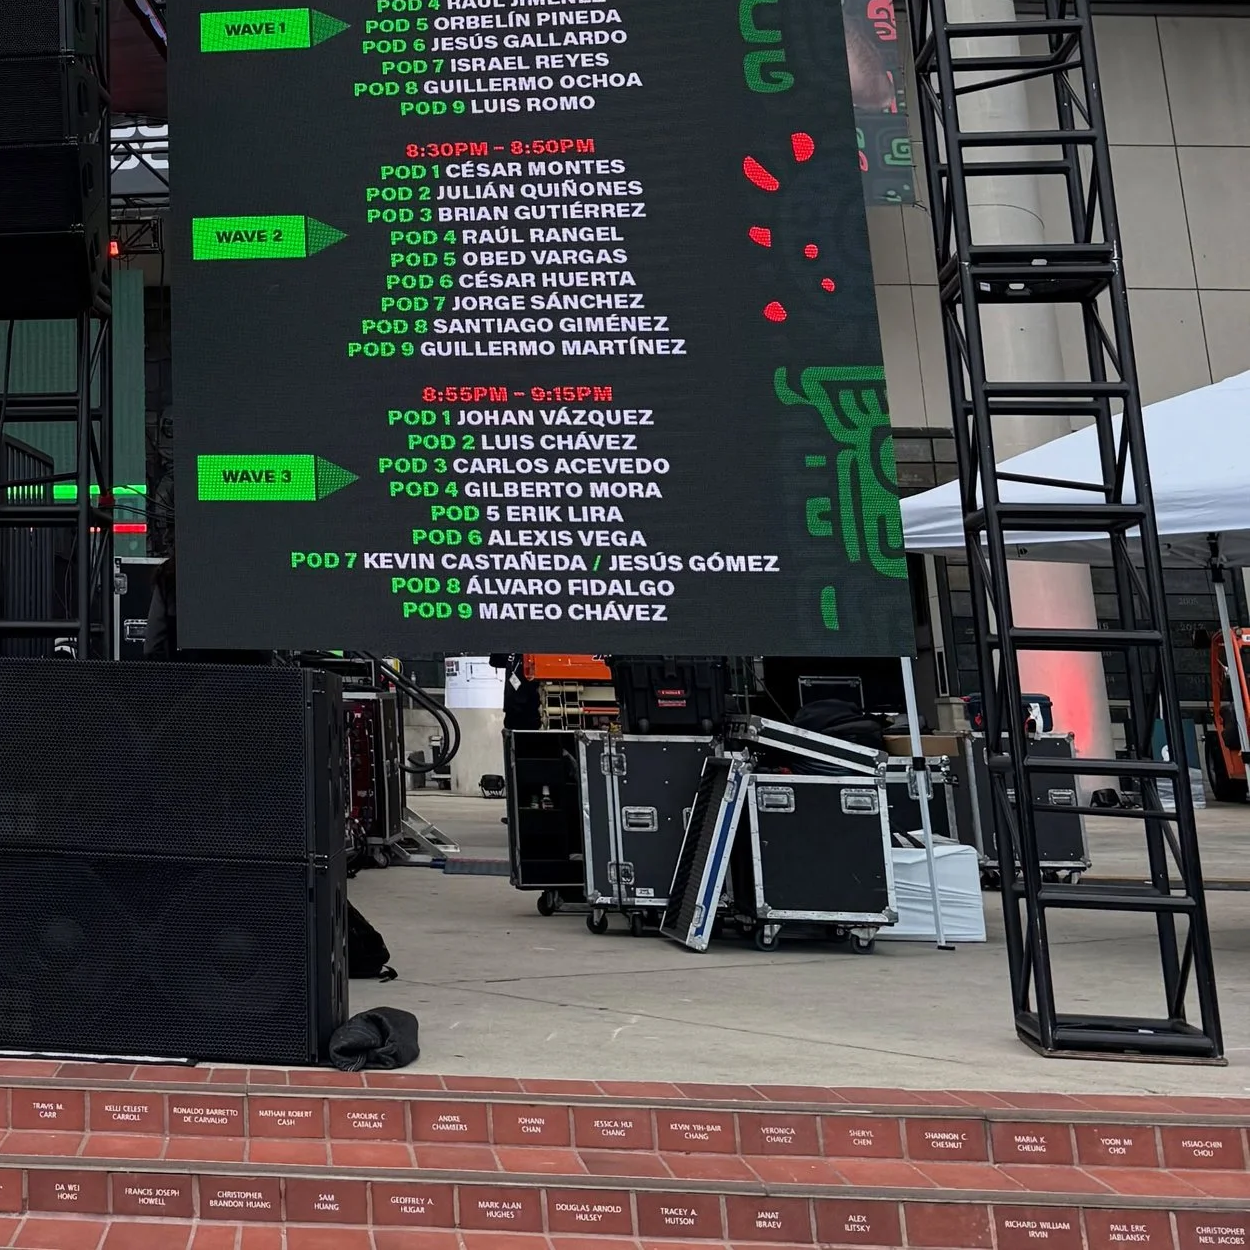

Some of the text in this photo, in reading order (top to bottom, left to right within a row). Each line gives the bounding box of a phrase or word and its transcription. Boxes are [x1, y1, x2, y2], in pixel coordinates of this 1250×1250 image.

[366, 9, 622, 33] POD 5 ORBELÍN PINEDA
[225, 22, 285, 36] WAVE 1
[355, 73, 642, 96] POD 8 GUILLERMO OCHOA
[401, 96, 595, 115] POD 9 LUIS ROMO
[407, 142, 488, 157] 8:30PM
[511, 139, 594, 154] 8:50PM
[381, 160, 625, 179] POD 1 CÉSAR MONTES
[216, 229, 283, 243] WAVE 2
[391, 226, 624, 245] POD 4 RAÚL RANGEL
[387, 271, 636, 289] POD 6 CÉSAR HUERTA
[382, 292, 644, 311] POD 7 JORGE SÁNCHEZ
[349, 336, 686, 356] POD 9 GUILLERMO MARTÍNEZ
[423, 387, 507, 401] 8:55PM
[531, 387, 612, 401] 9:15PM
[389, 407, 654, 427] POD 1 JOHAN VÁZQUEZ
[409, 431, 637, 450] POD 2 LUIS CHÁVEZ
[223, 470, 291, 483] WAVE 3
[390, 482, 662, 498] POD 4 GILBERTO MORA
[292, 551, 779, 571] POD 7 KEVIN CASTAÑEDA / JESÚS GÓMEZ
[392, 575, 674, 596] POD 8 ÁLVARO FIDALGO
[403, 601, 667, 621] POD 9 MATEO CHÁVEZ
[173, 1107, 203, 1115] RONALDO
[57, 1192, 78, 1200] HONG
[125, 1188, 153, 1196] FRANCIS
[217, 1191, 262, 1199] CHRISTOPHER
[138, 1197, 166, 1205] HOWELL
[210, 1200, 271, 1209] BRANDON HUANG
[314, 1202, 339, 1211] HUANG
[478, 1201, 499, 1209] MARK
[486, 1210, 515, 1219] HUGHES
[556, 1203, 621, 1213] DOUGLAS ARNOLD
[660, 1208, 688, 1216] TRACEY
[575, 1213, 602, 1222] HULSEY
[665, 1216, 694, 1225] HUTSON
[1005, 1220, 1070, 1230] RICHARD WILLIAM
[1131, 1225, 1147, 1233] ERIC
[1196, 1227, 1245, 1235] CHRISTOPHER
[1028, 1230, 1048, 1238] IRVIN
[1199, 1236, 1245, 1245] NEIL JACOBS
